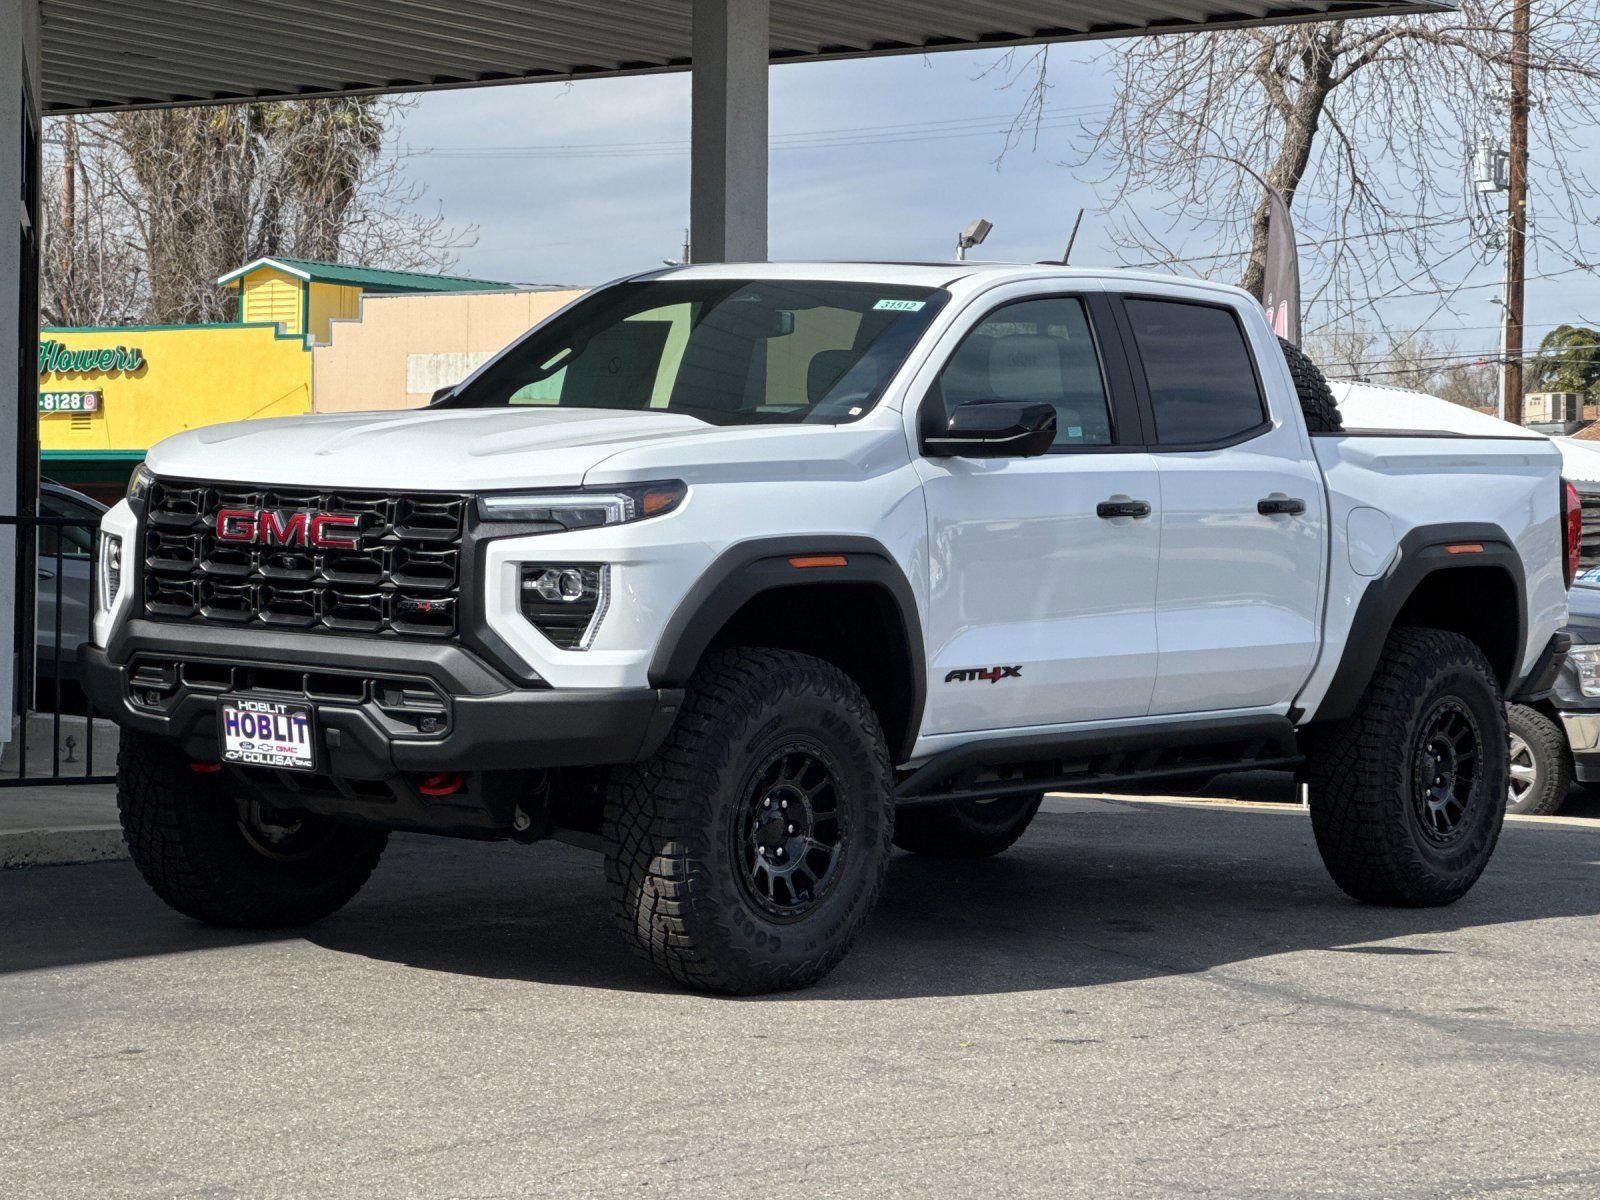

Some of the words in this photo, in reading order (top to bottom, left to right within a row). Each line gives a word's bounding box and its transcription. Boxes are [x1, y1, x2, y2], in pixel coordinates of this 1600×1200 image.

[880, 301, 917, 310] 31512
[216, 509, 361, 550] GMC
[945, 665, 1023, 684] AT4X
[238, 700, 287, 714] HOBLIT
[224, 710, 307, 744] HOBLIT
[276, 745, 298, 754] GMC
[243, 752, 293, 766] COLUSA
